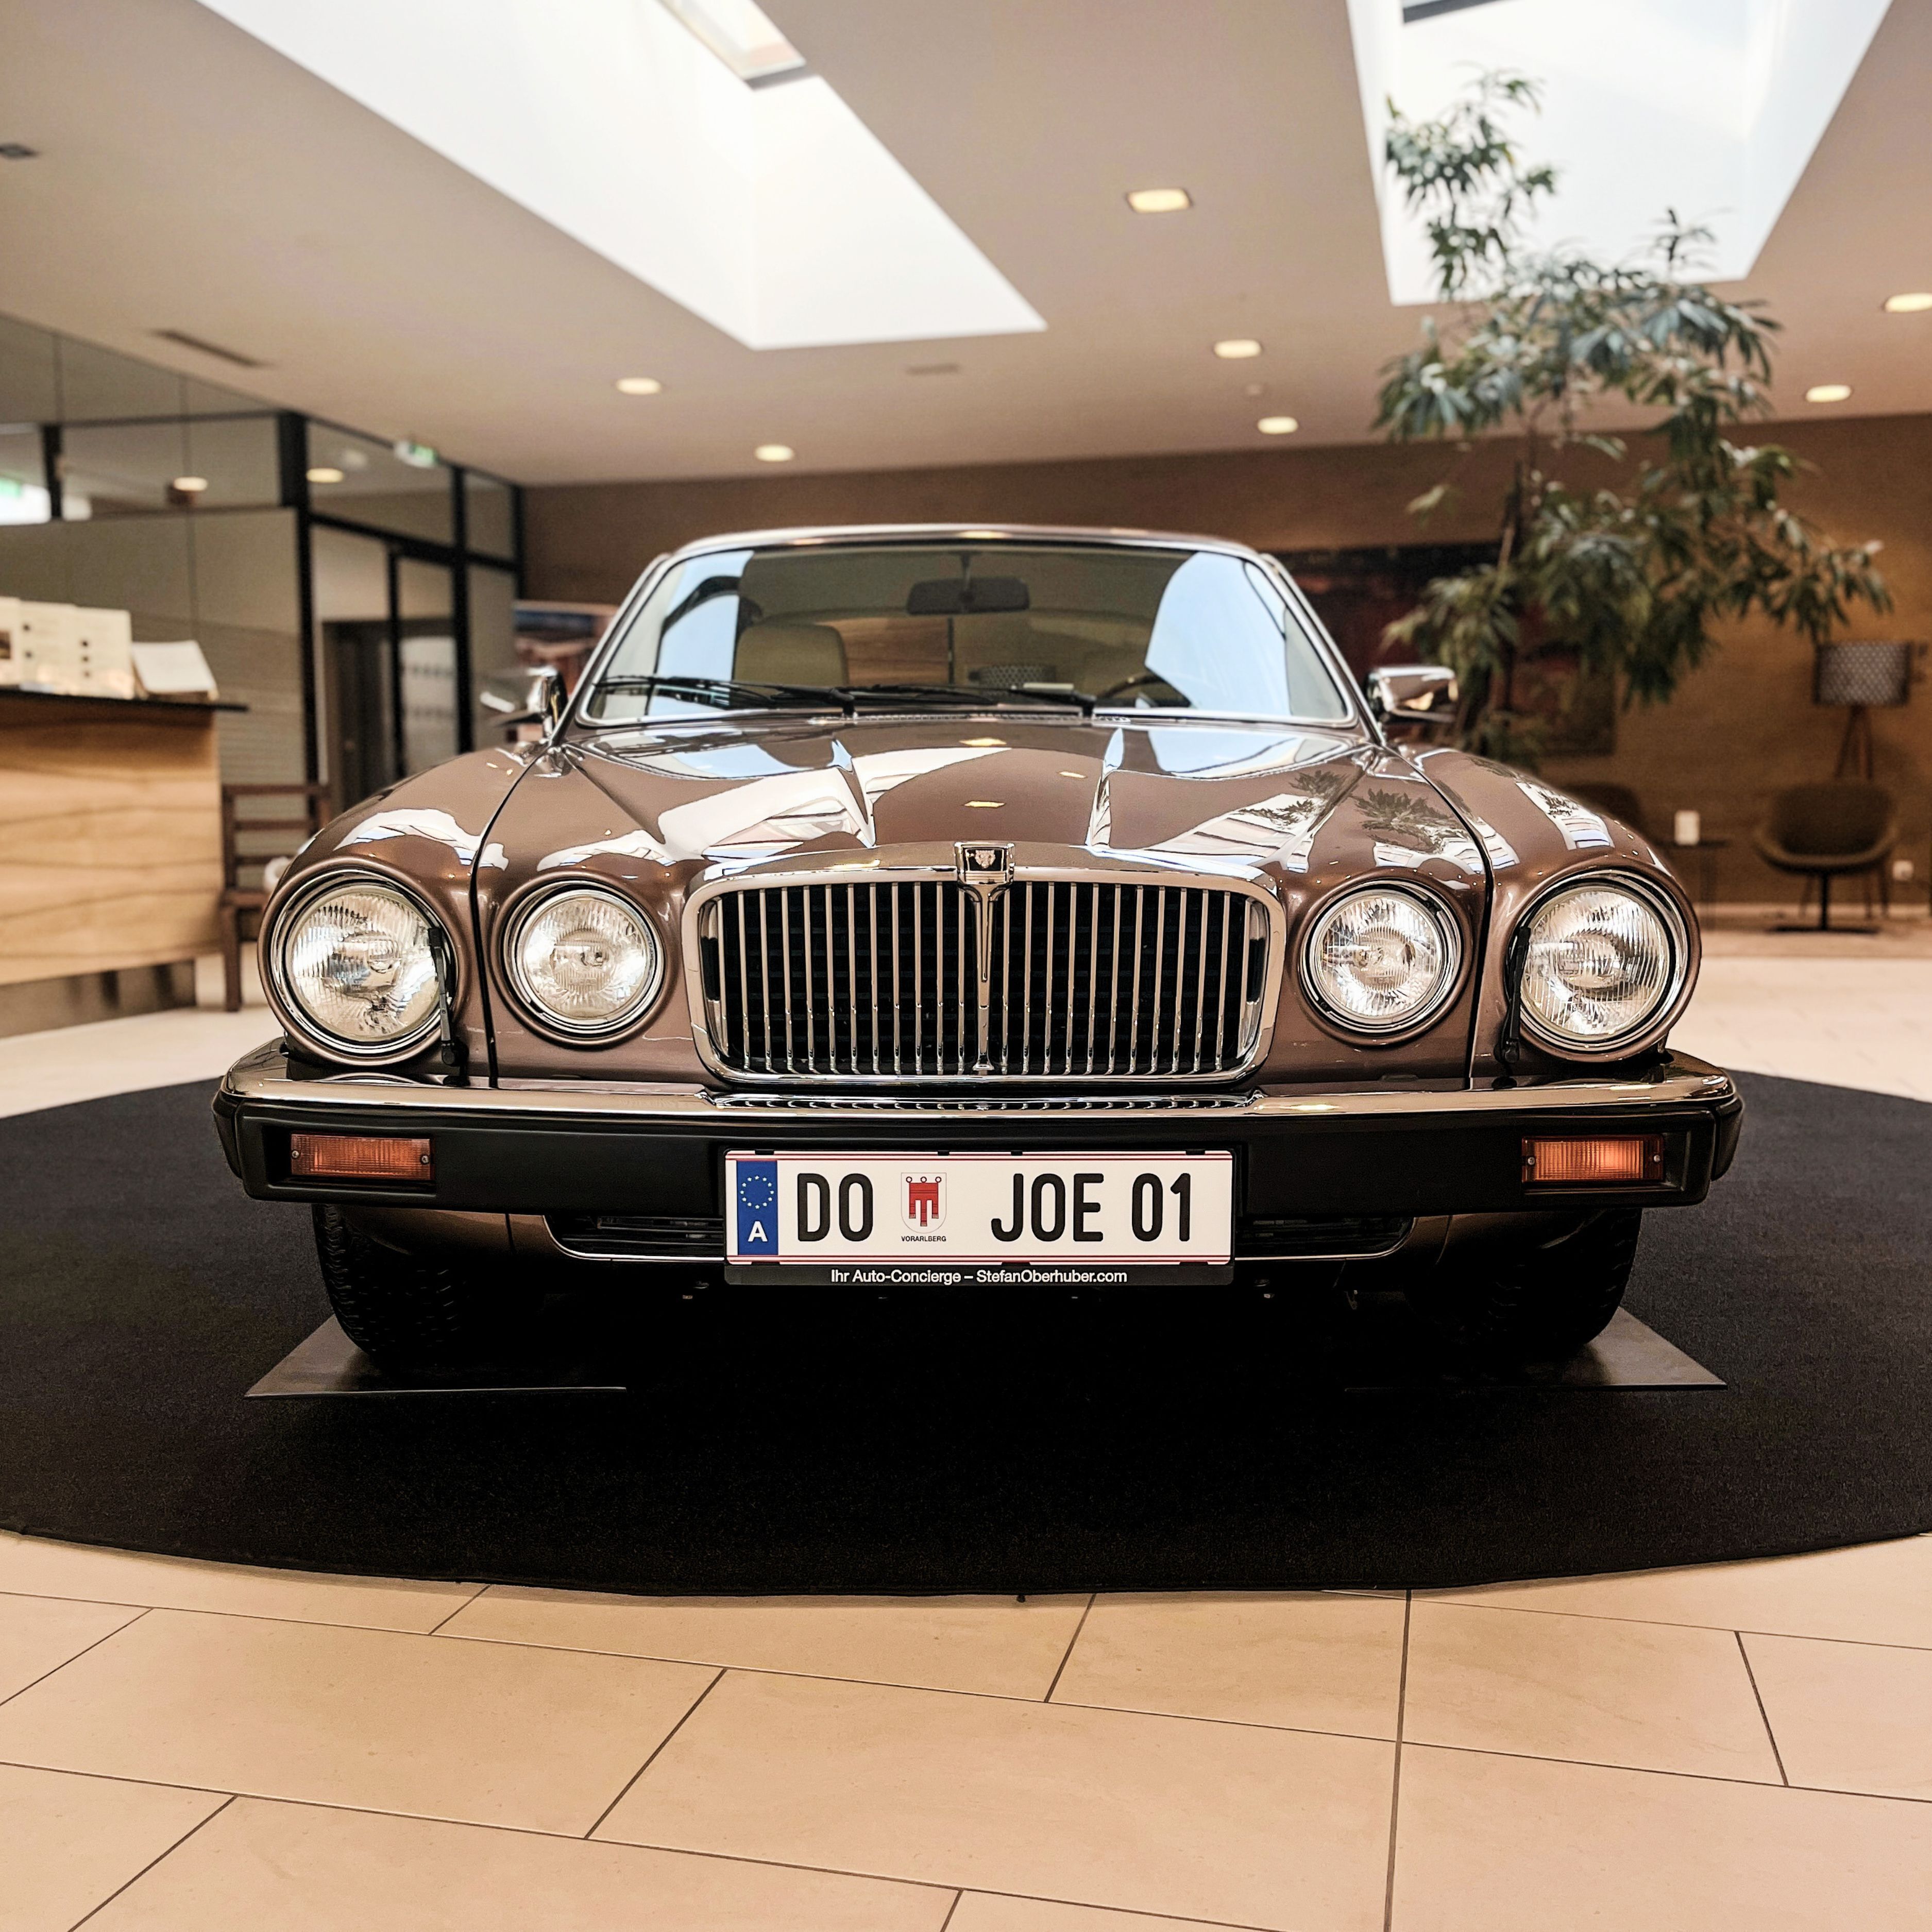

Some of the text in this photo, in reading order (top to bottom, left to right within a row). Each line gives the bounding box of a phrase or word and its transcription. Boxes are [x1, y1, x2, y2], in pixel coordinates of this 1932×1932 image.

[797, 1173, 1191, 1242] DO JOE 01
[748, 1221, 768, 1242] A
[831, 1269, 850, 1282] Ihr
[852, 1269, 961, 1285] Auto-Concierge
[976, 1269, 1127, 1283] StefanOberhuber.com
